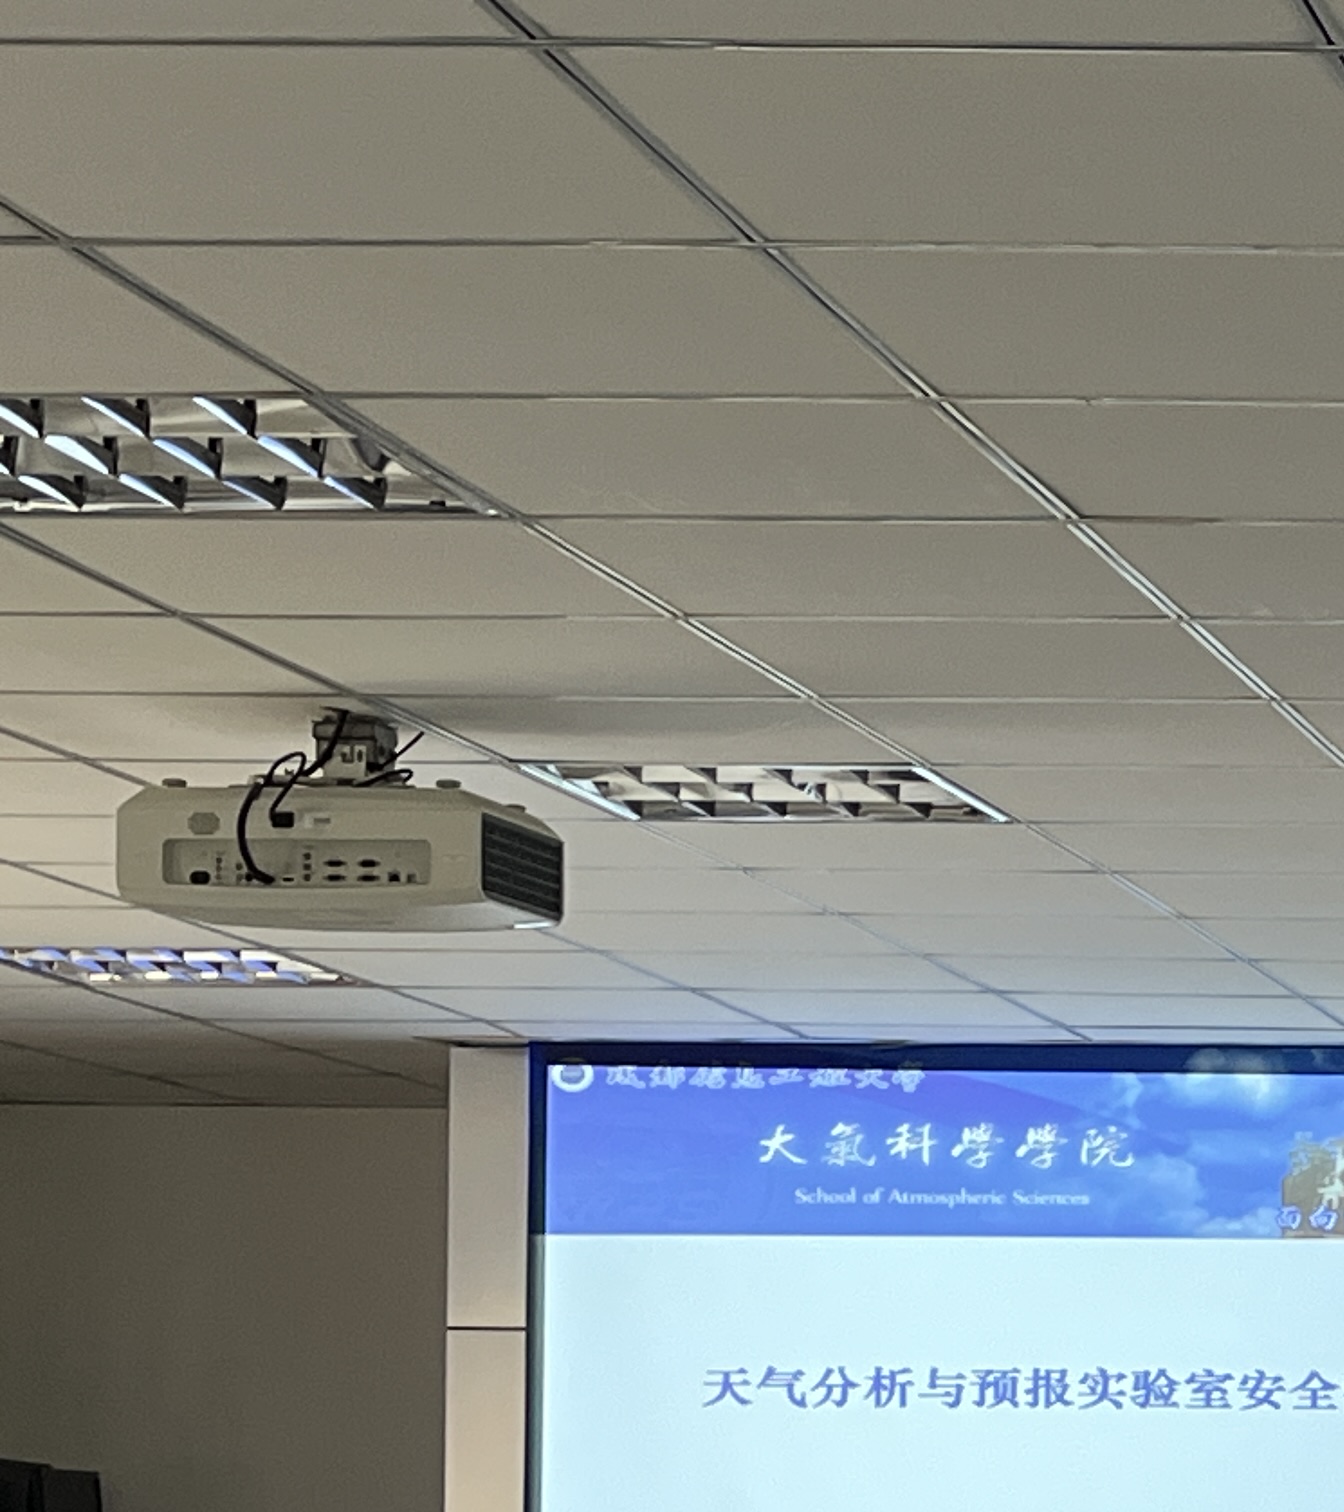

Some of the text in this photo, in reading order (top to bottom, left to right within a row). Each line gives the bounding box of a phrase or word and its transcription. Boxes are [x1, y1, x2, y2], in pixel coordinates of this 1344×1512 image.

[794, 1186, 1090, 1209] School of Atmospheric Sciences
